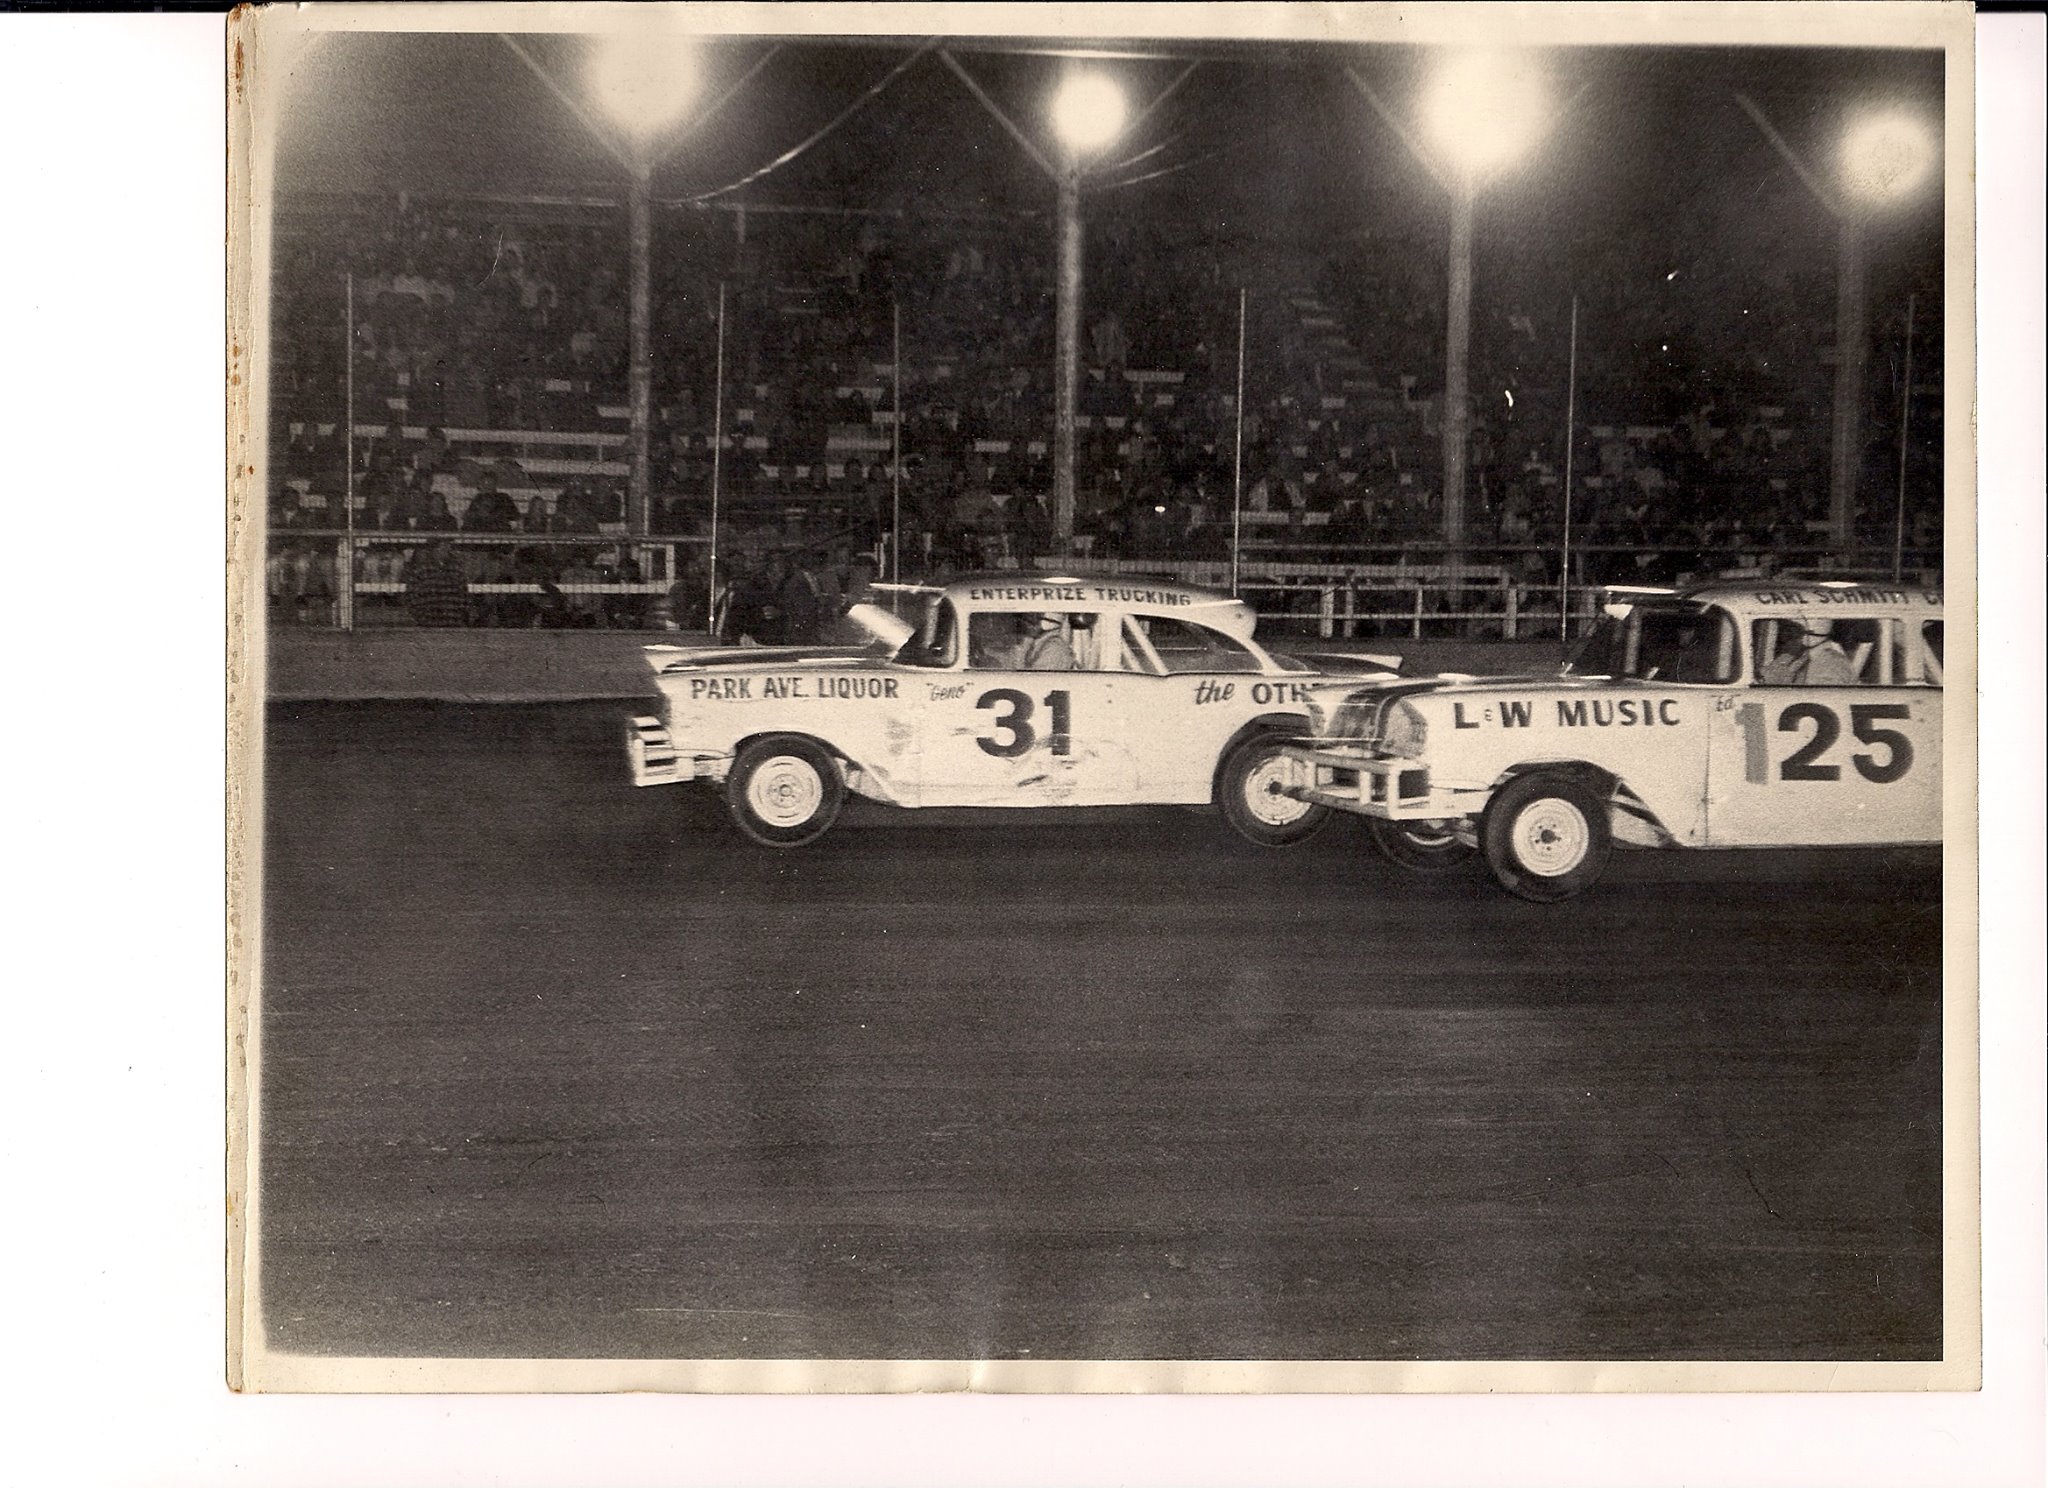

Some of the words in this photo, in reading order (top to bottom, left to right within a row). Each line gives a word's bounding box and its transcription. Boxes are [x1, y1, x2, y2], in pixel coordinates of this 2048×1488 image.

[972, 586, 1087, 601] ENTERPRIZE
[1094, 587, 1191, 606] TRUCKING
[691, 678, 752, 699] PARK
[818, 678, 899, 699] LIQUOR
[1195, 680, 1235, 705] the
[1251, 682, 1323, 703] OTH
[976, 688, 1071, 758] 31
[1558, 699, 1681, 727] MUSIC
